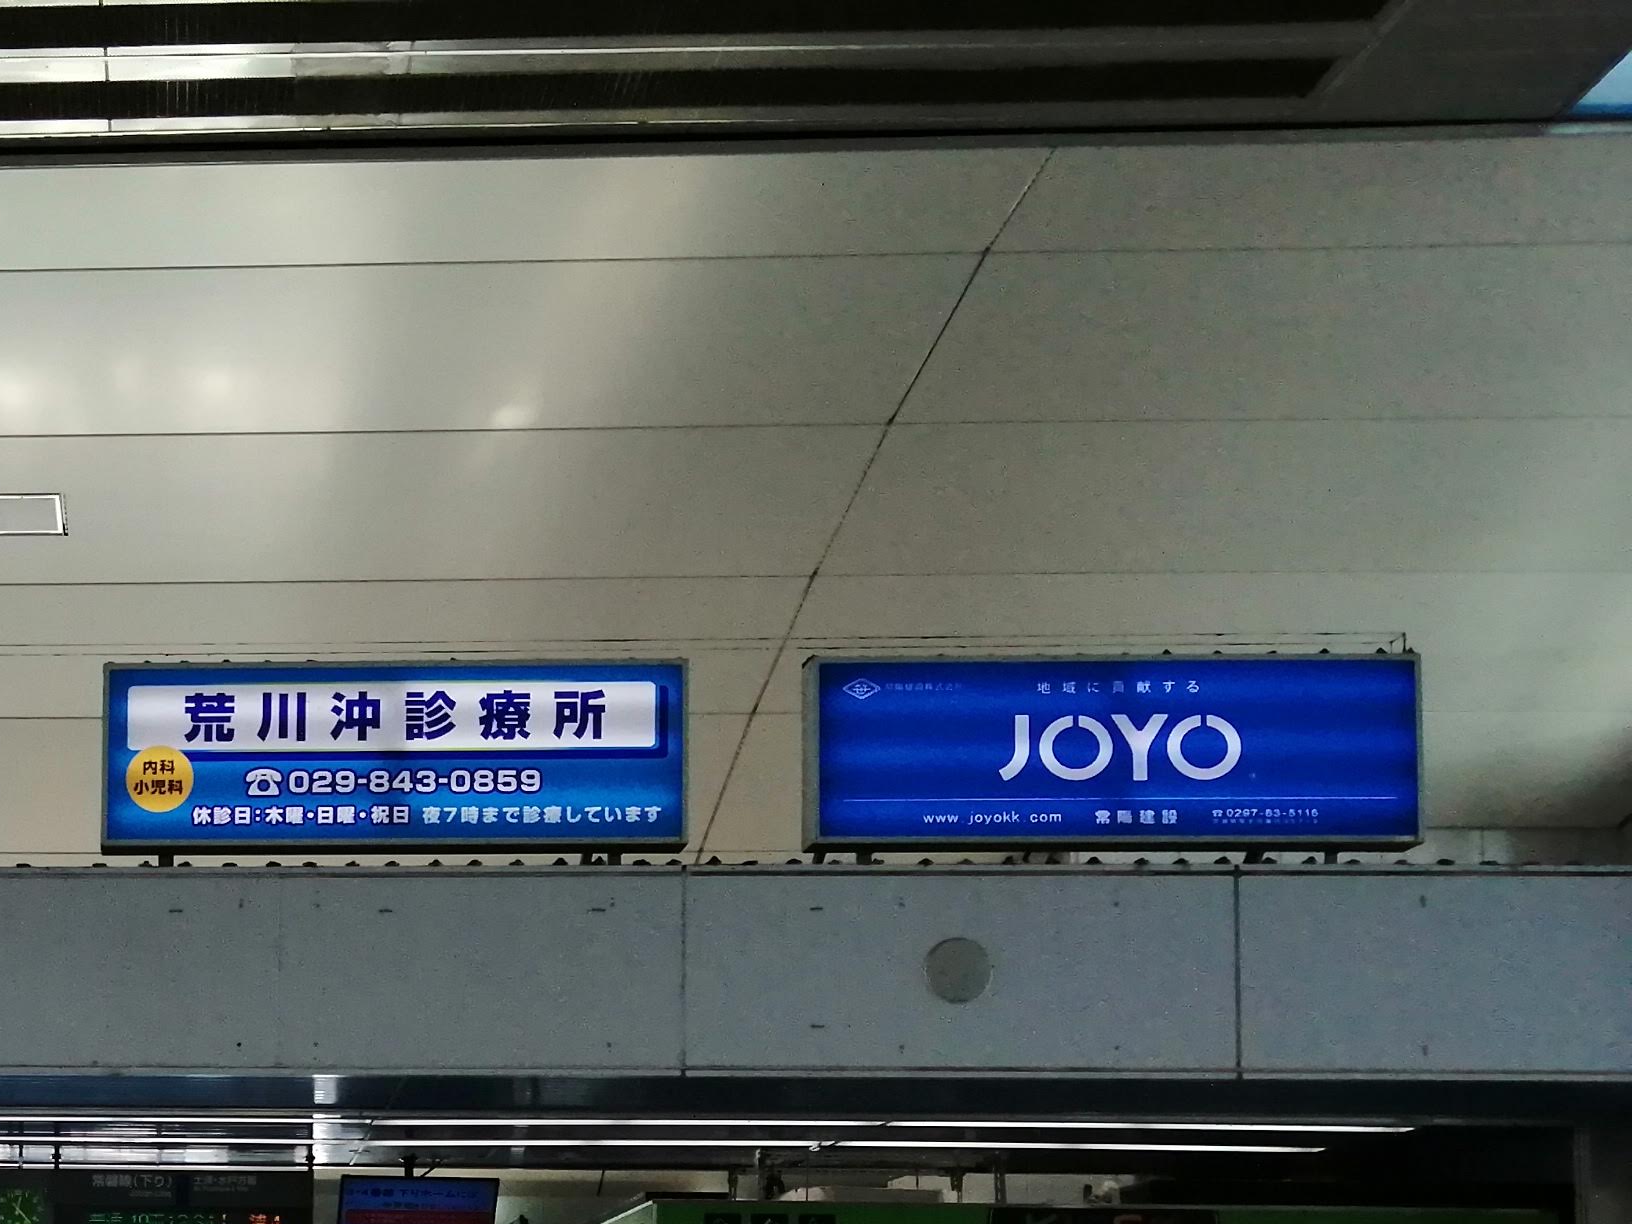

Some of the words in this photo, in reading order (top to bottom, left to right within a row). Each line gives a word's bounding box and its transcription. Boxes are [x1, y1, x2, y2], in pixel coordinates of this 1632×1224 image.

[1036, 680, 1201, 694] 地域に貢献する
[184, 689, 606, 743] 荒川沖診療所
[998, 714, 1242, 782] JOYO
[142, 760, 175, 775] 内科
[133, 779, 184, 796] 小児科
[288, 769, 542, 793] 029-843-0859
[422, 805, 662, 824] 夜7時まで診療しています
